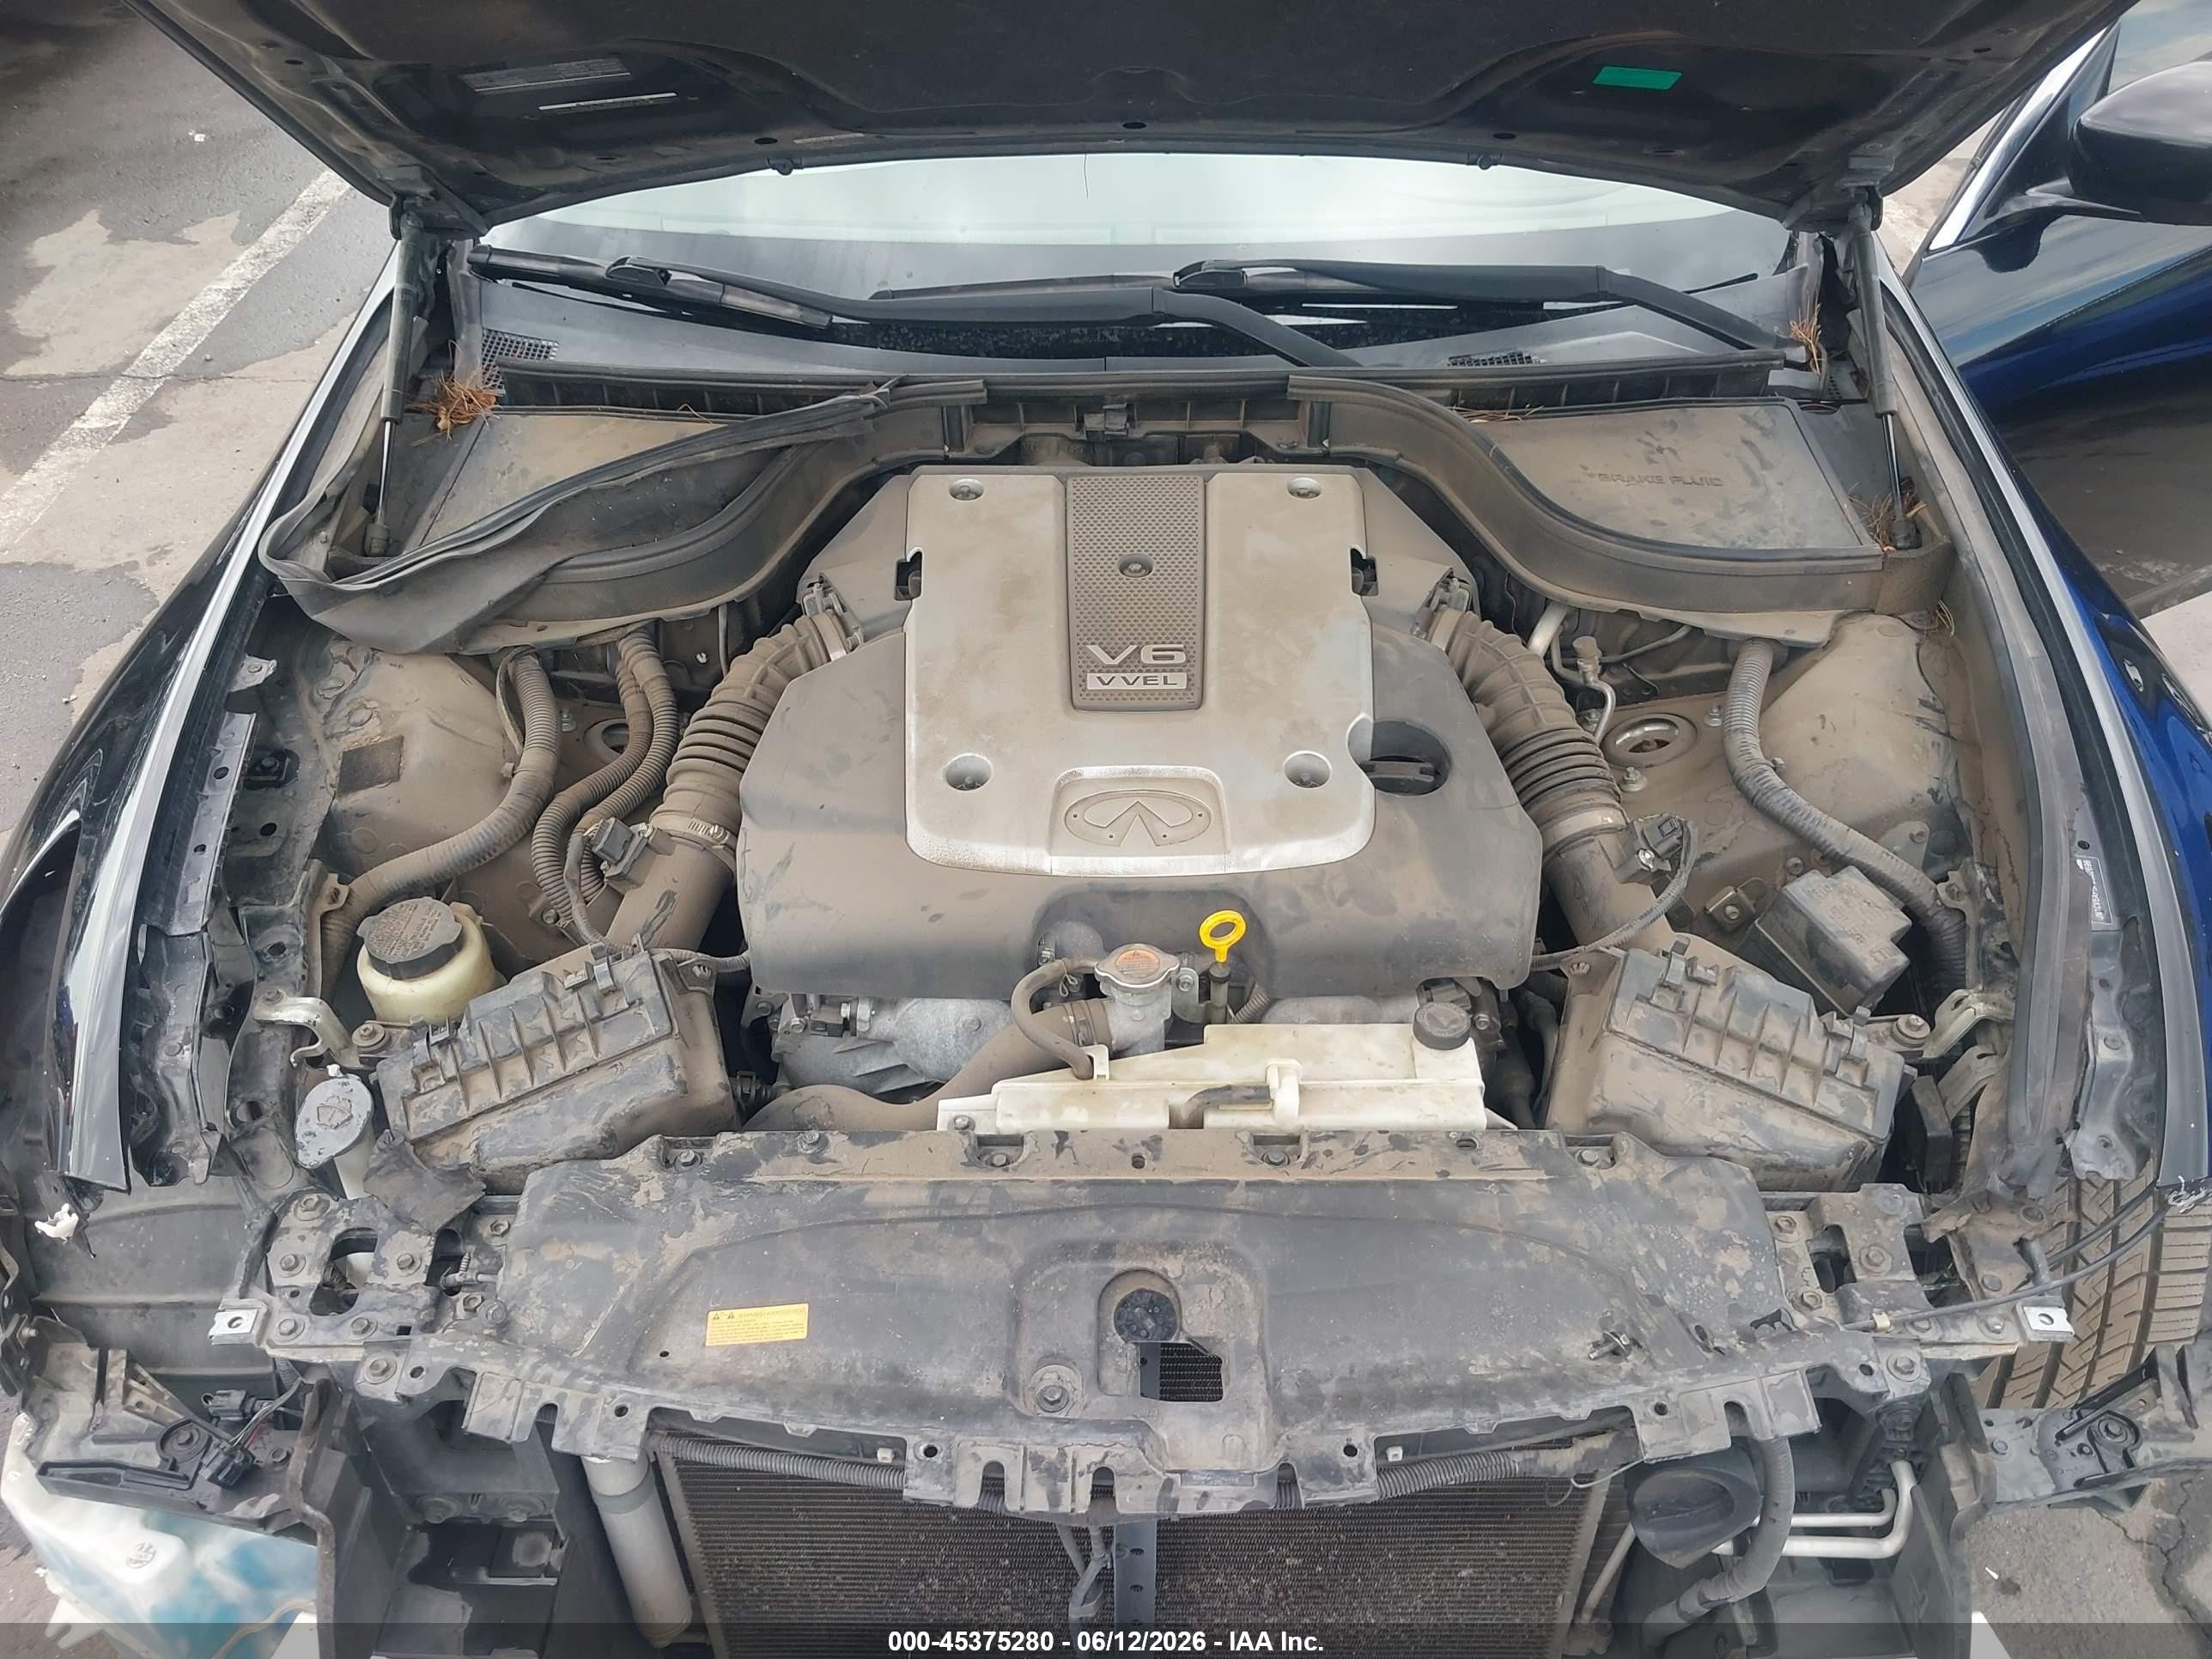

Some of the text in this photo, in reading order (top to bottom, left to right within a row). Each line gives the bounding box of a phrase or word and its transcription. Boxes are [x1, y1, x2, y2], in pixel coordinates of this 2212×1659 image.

[1597, 472, 1665, 485] BRAKE
[1086, 645, 1187, 665] V6
[1096, 675, 1178, 686] VVEL
